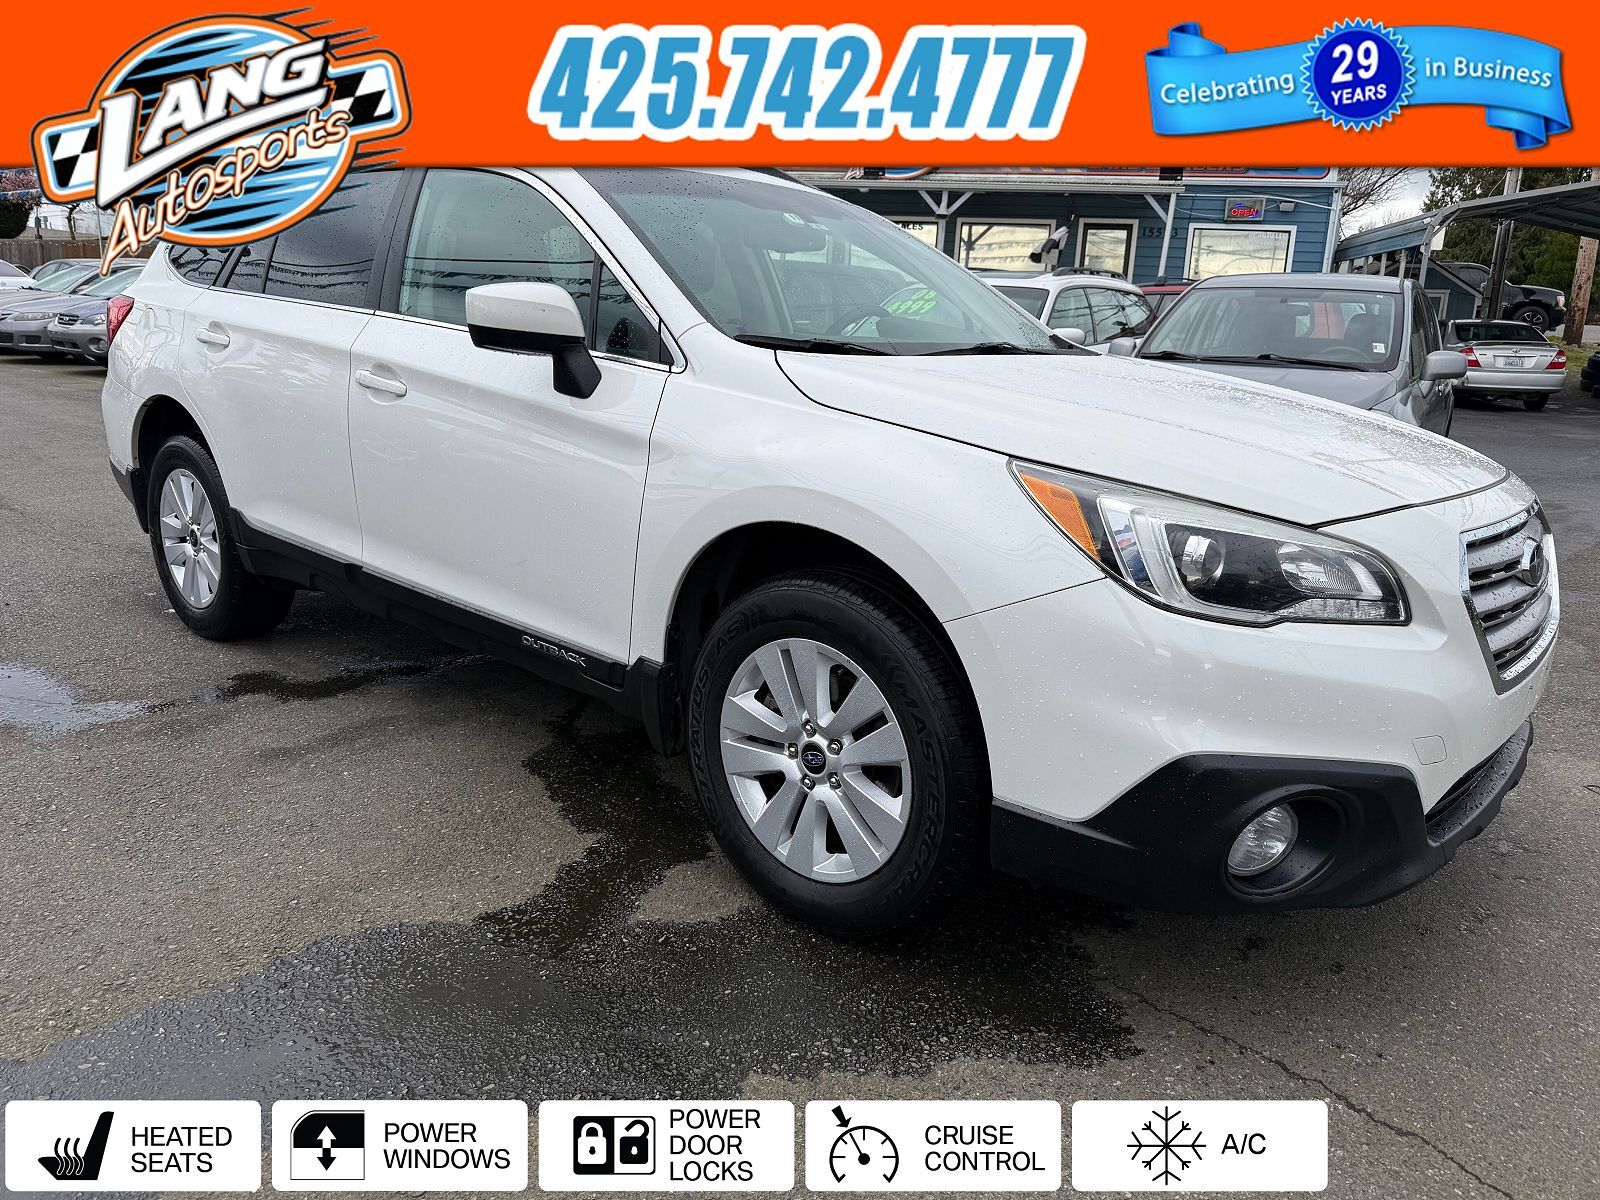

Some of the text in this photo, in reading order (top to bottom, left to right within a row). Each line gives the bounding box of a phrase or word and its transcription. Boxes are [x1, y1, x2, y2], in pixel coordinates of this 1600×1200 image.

[1231, 208, 1259, 217] OPEN
[1142, 228, 1178, 238] 1553
[521, 635, 587, 667] OUTBACK
